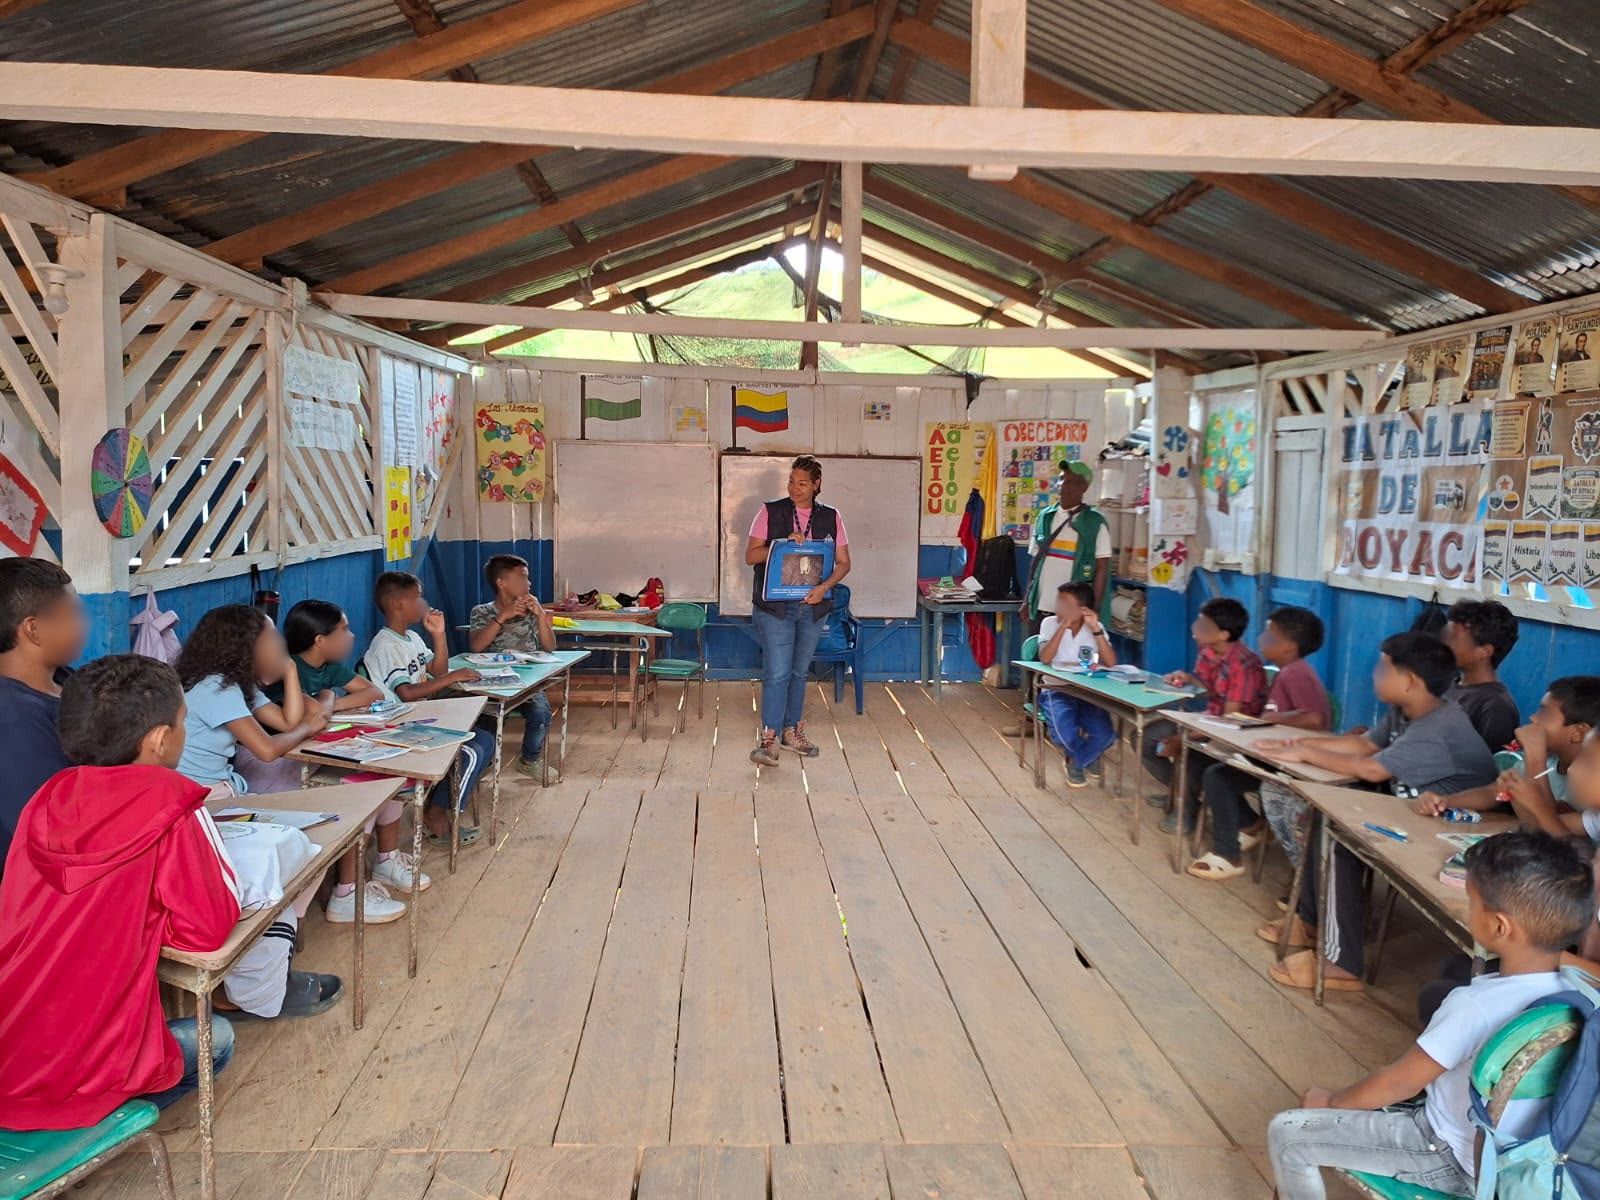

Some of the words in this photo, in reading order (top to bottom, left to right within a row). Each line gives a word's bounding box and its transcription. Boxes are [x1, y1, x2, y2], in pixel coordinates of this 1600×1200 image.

[929, 430, 946, 445] A
[947, 430, 961, 444] a
[1003, 421, 1089, 442] ABECEDARIO
[930, 447, 944, 463] E
[946, 447, 960, 462] e
[931, 465, 942, 481] I
[949, 462, 956, 481] i
[928, 482, 944, 498] O
[946, 482, 958, 496] o
[1378, 474, 1417, 514] DE
[928, 498, 942, 514] U
[945, 499, 957, 513] u
[1341, 526, 1478, 583] BOYAC
[1514, 545, 1540, 556] Historia
